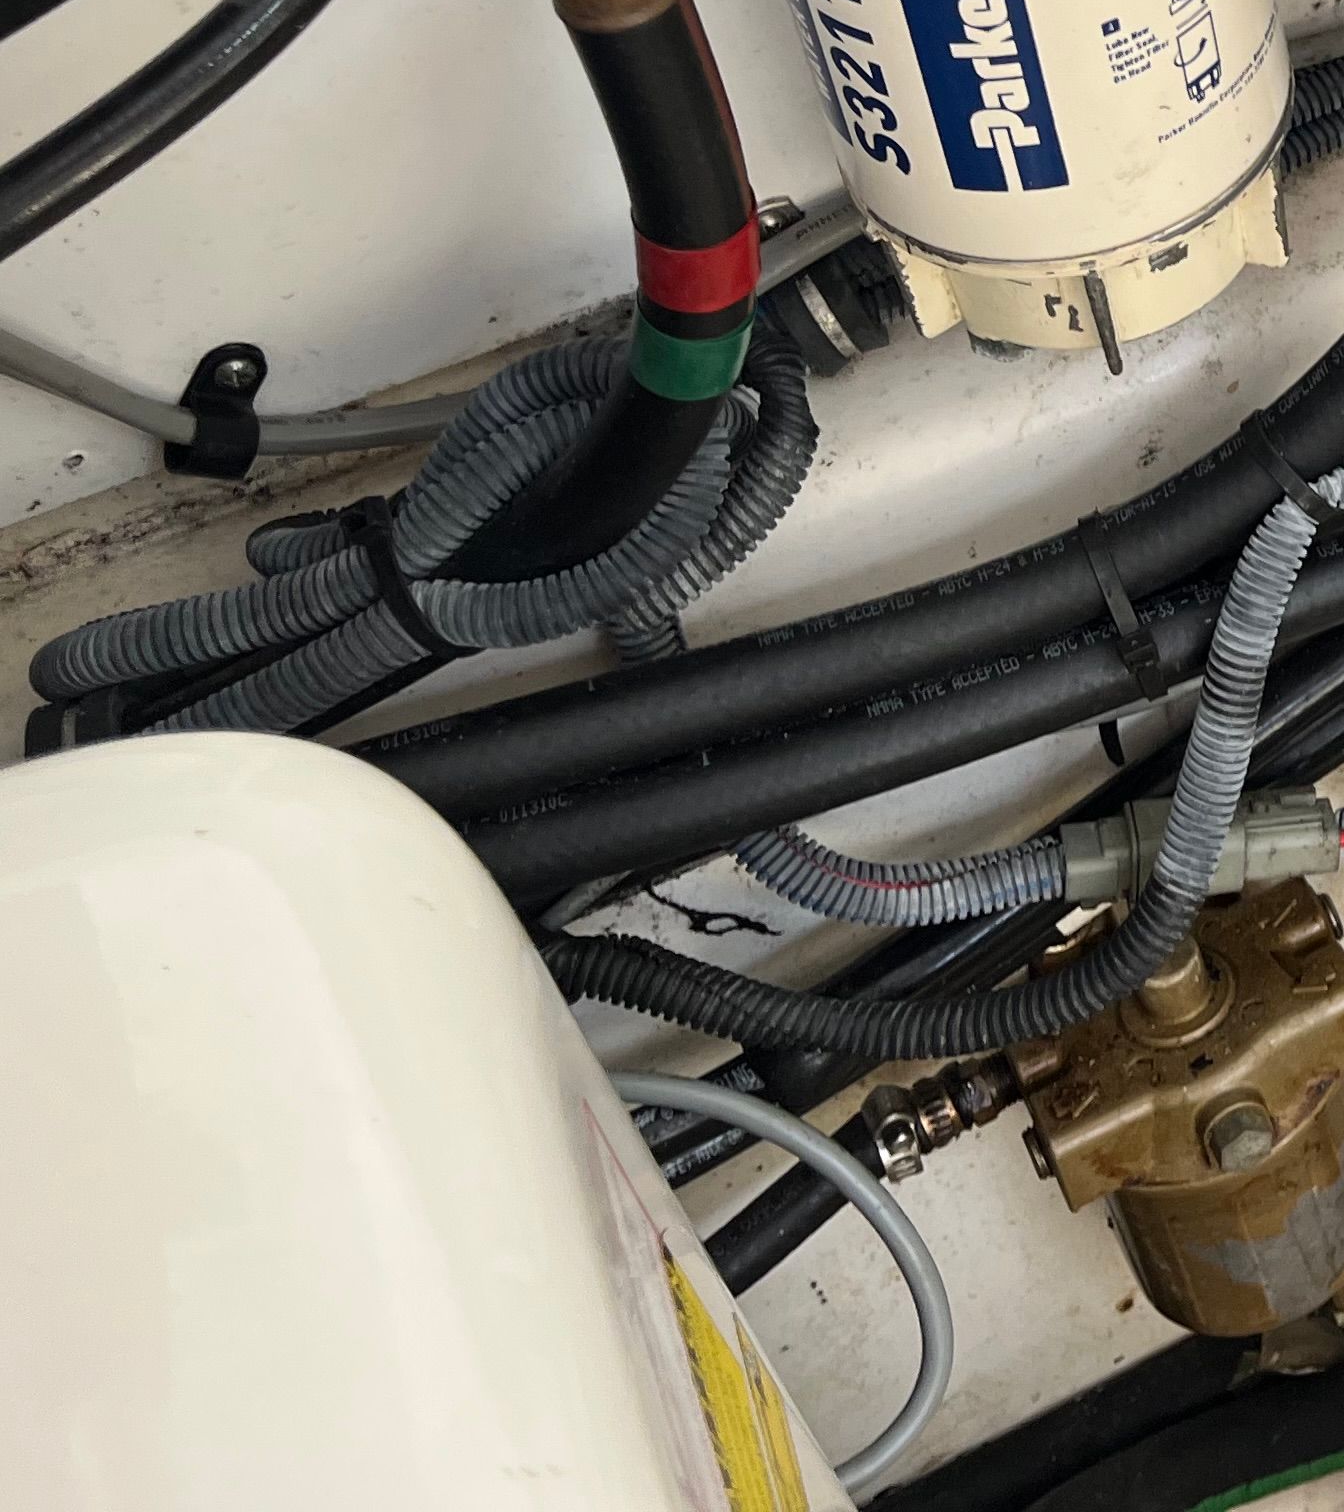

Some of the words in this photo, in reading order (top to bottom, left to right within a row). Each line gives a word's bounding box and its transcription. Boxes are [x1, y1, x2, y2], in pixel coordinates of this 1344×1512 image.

[1105, 37, 1128, 52] Lube
[1131, 27, 1149, 40] New
[1108, 45, 1134, 62] Filter
[1111, 54, 1145, 73] Tighten
[1147, 40, 1169, 58] Filter
[1114, 73, 1126, 84] On
[1129, 61, 1151, 78] Head
[1158, 123, 1186, 144] Parker
[801, 613, 838, 636] TYPE
[844, 593, 916, 625] ACCEPTED
[977, 560, 1012, 583] H-24
[1032, 541, 1066, 564] H-33
[866, 695, 904, 719] NMMA
[910, 678, 947, 706] TYPE
[951, 657, 1021, 691] ACCEPTED
[1042, 635, 1079, 661] ABYC
[1083, 620, 1118, 645] H-24
[1139, 600, 1175, 624] H-33
